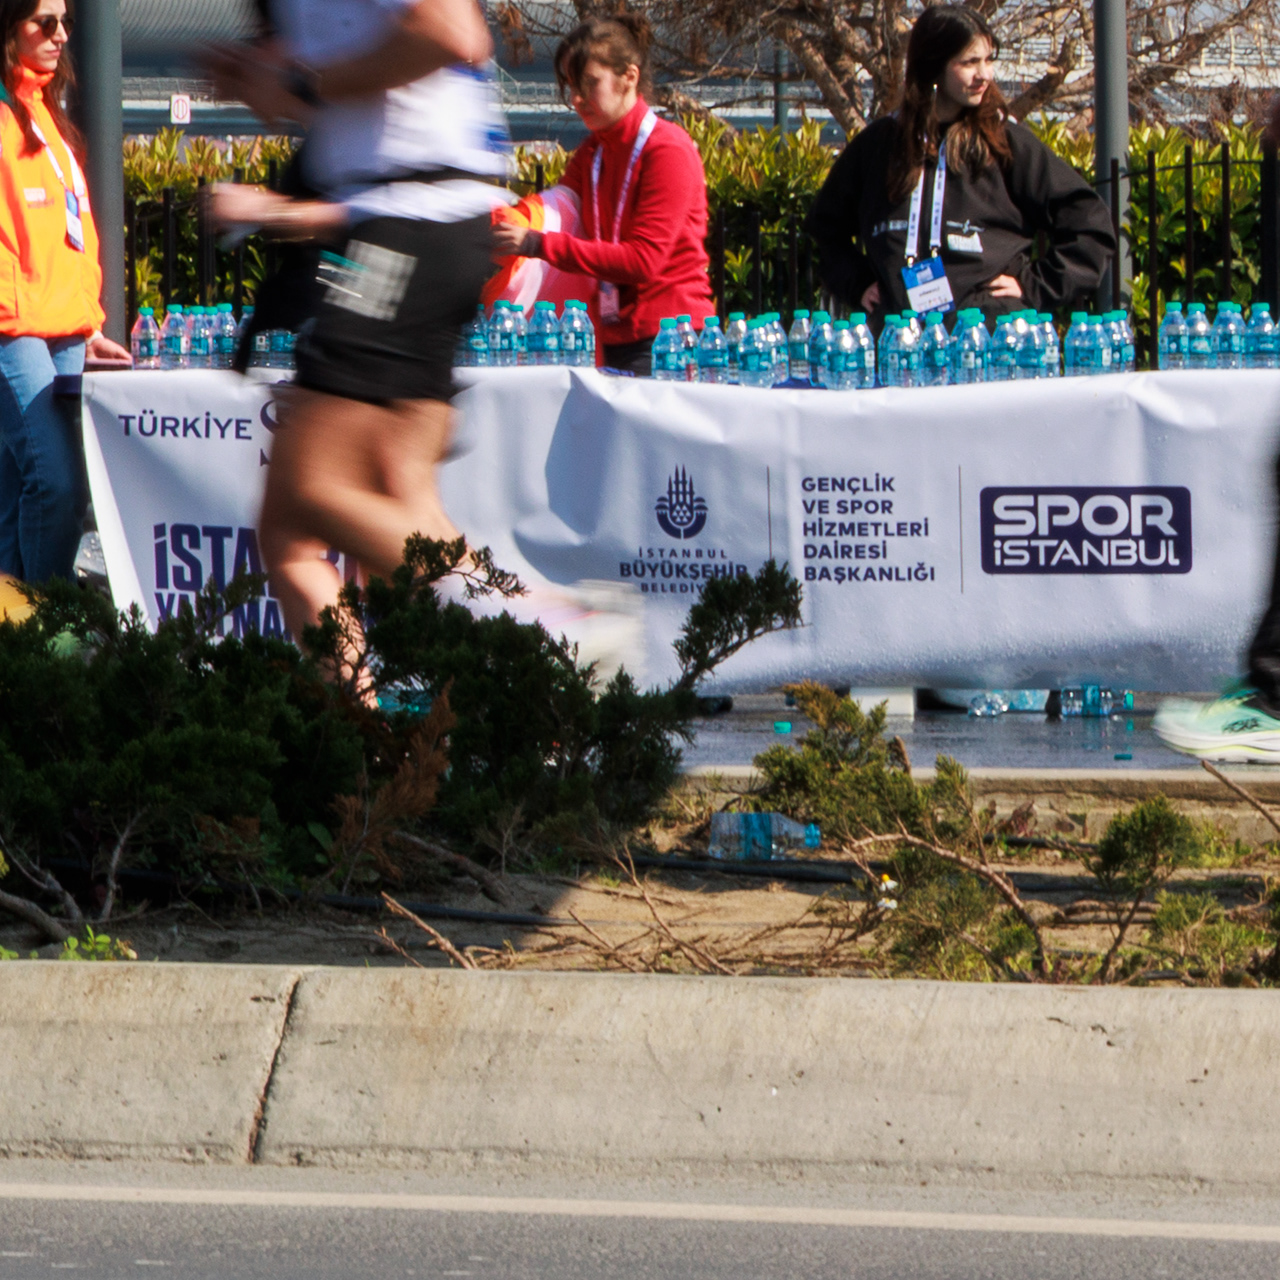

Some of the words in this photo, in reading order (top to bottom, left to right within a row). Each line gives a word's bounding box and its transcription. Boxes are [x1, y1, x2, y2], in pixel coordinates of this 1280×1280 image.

[118, 410, 252, 440] TÜRKİYE
[801, 473, 895, 495] GENÇLİK
[802, 500, 830, 514] VE
[836, 499, 893, 514] SPOR
[993, 495, 1178, 536] SPOR
[803, 518, 929, 537] HİZMETLERİ
[639, 546, 727, 559] İSTANBUL
[803, 540, 888, 559] DAİRESİ
[804, 563, 935, 584] BAŞKANLIĞI
[641, 581, 706, 593] BELEDİY
